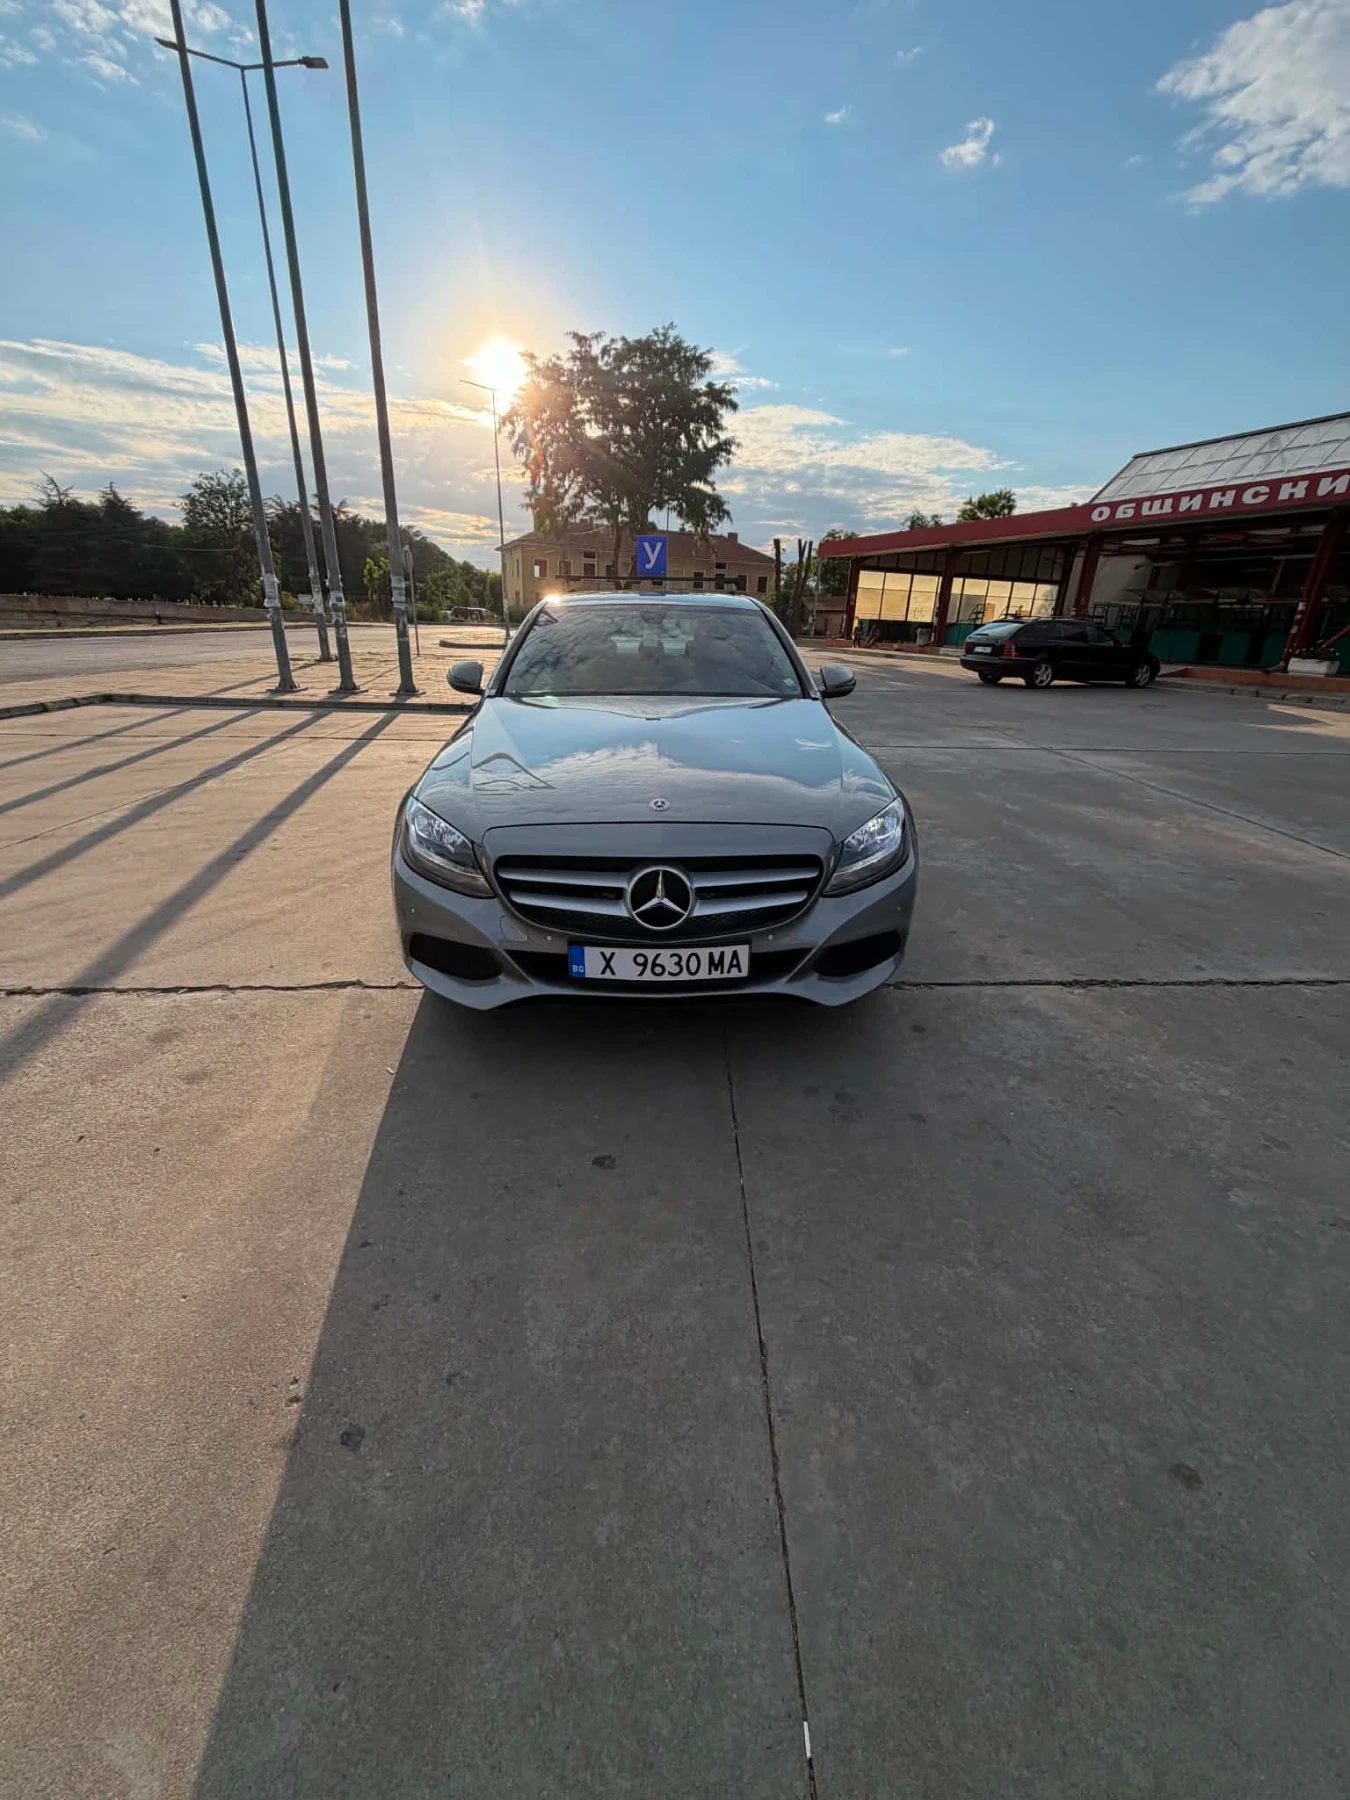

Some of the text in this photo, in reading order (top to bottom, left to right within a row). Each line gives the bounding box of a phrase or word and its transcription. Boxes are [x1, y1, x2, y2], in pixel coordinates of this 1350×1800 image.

[572, 964, 584, 973] BG
[600, 949, 742, 977] X 9630 MA
